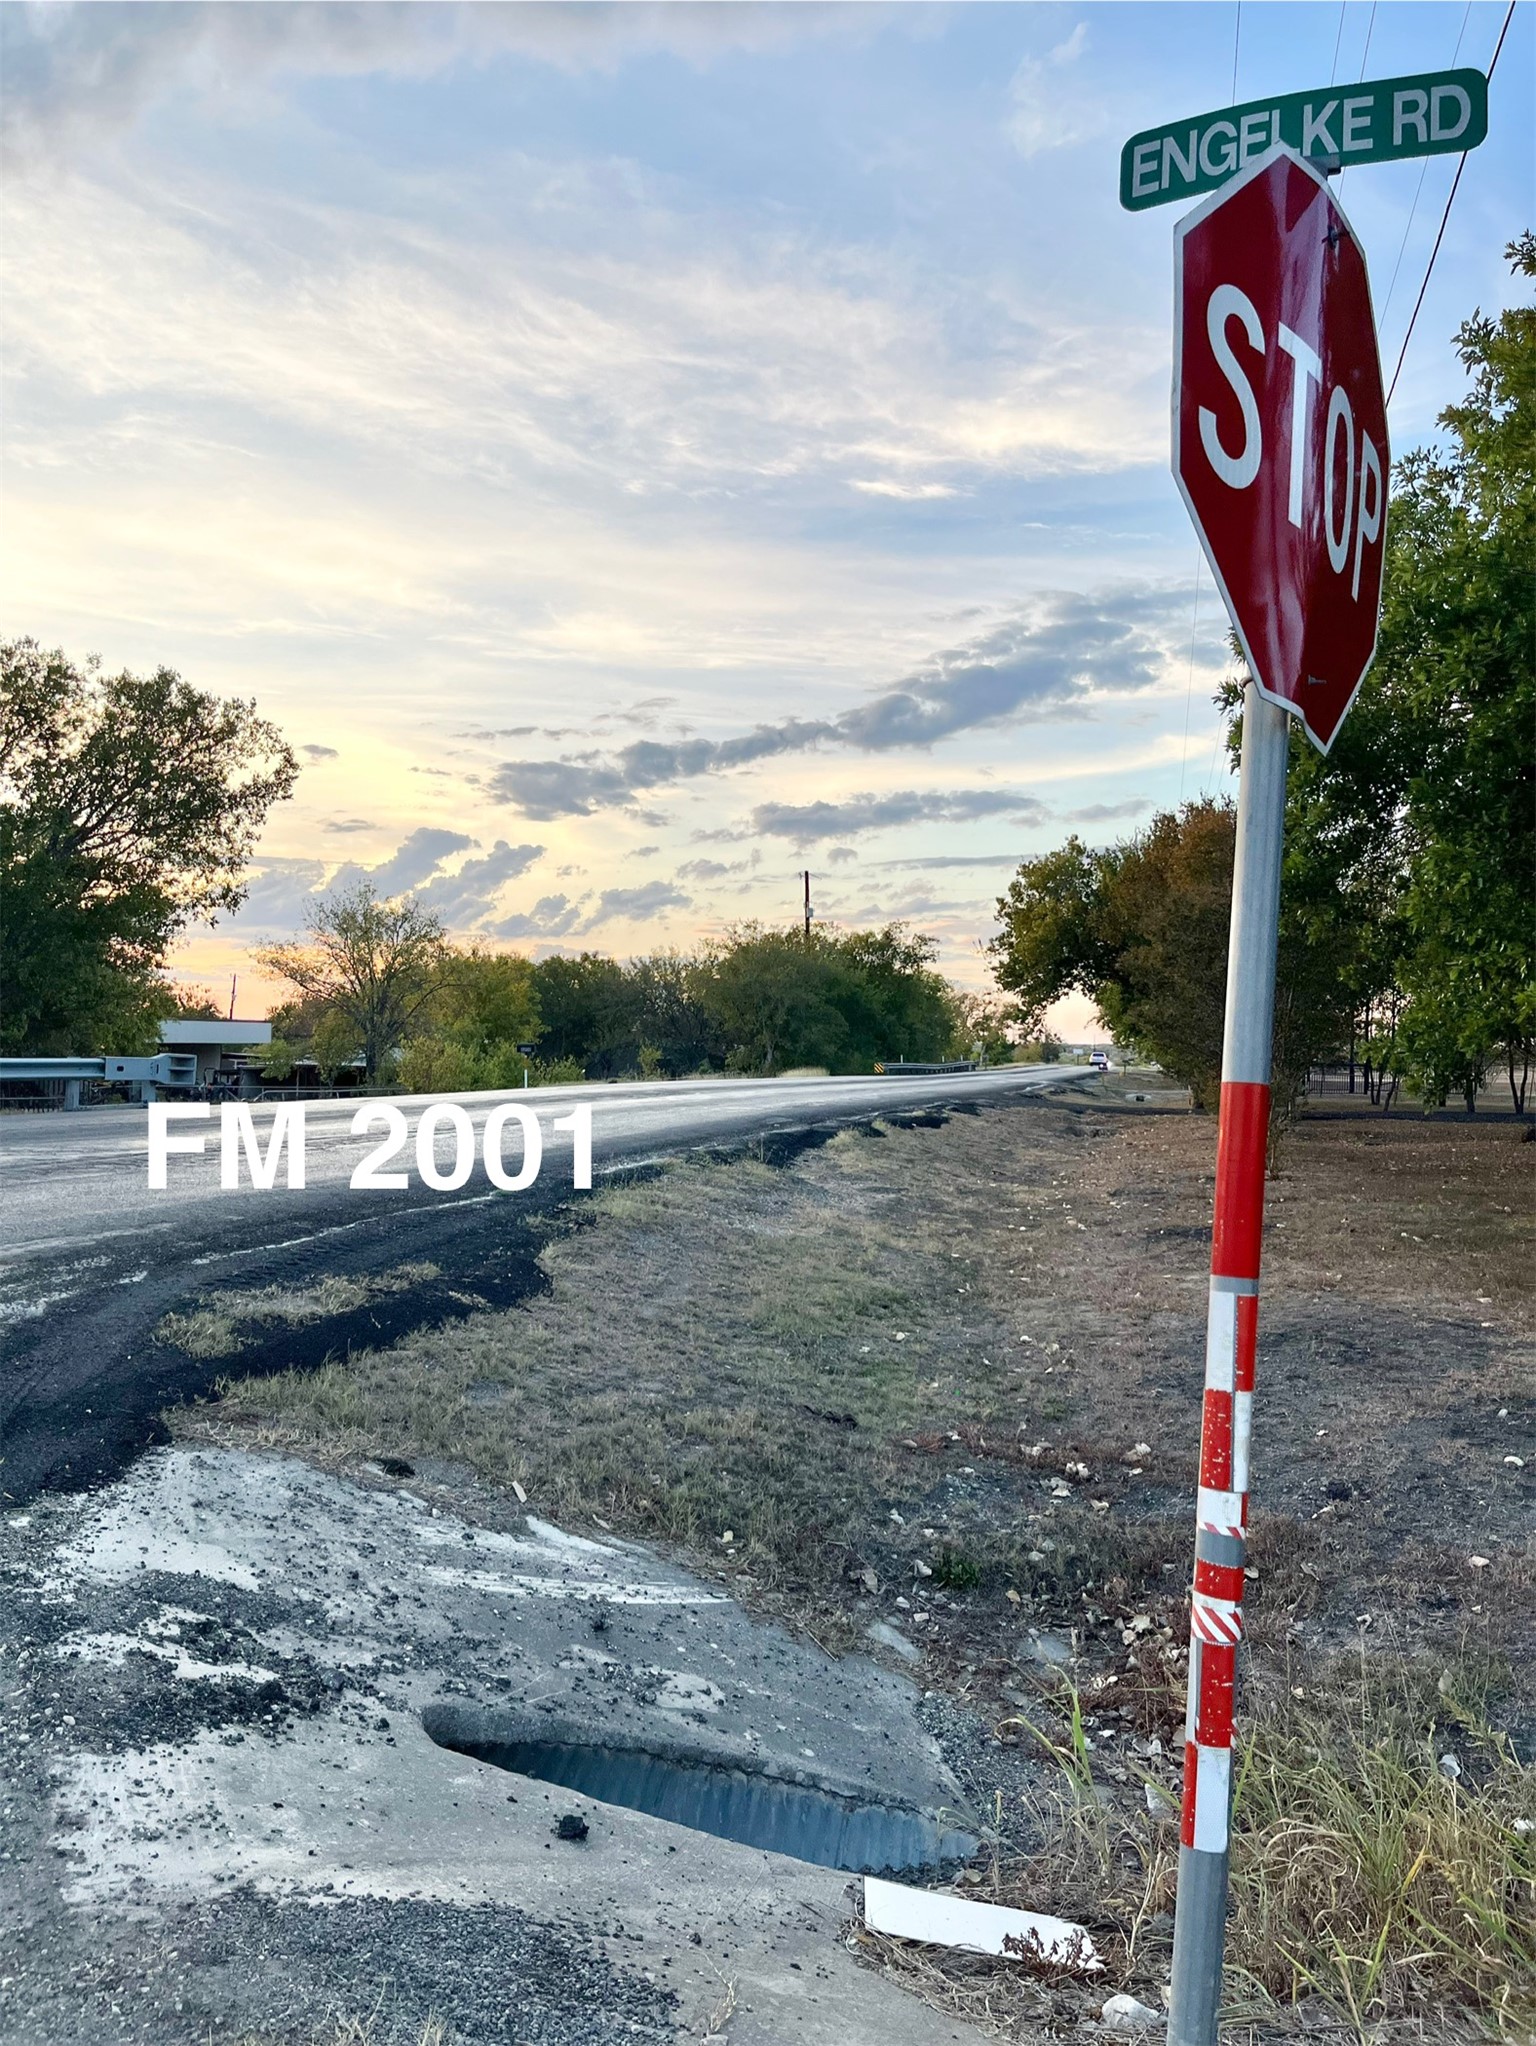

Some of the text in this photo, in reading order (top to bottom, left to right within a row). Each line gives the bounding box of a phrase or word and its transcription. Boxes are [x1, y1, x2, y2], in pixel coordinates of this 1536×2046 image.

[1131, 84, 1471, 198] ENGELKE RD
[1198, 284, 1382, 603] STOP
